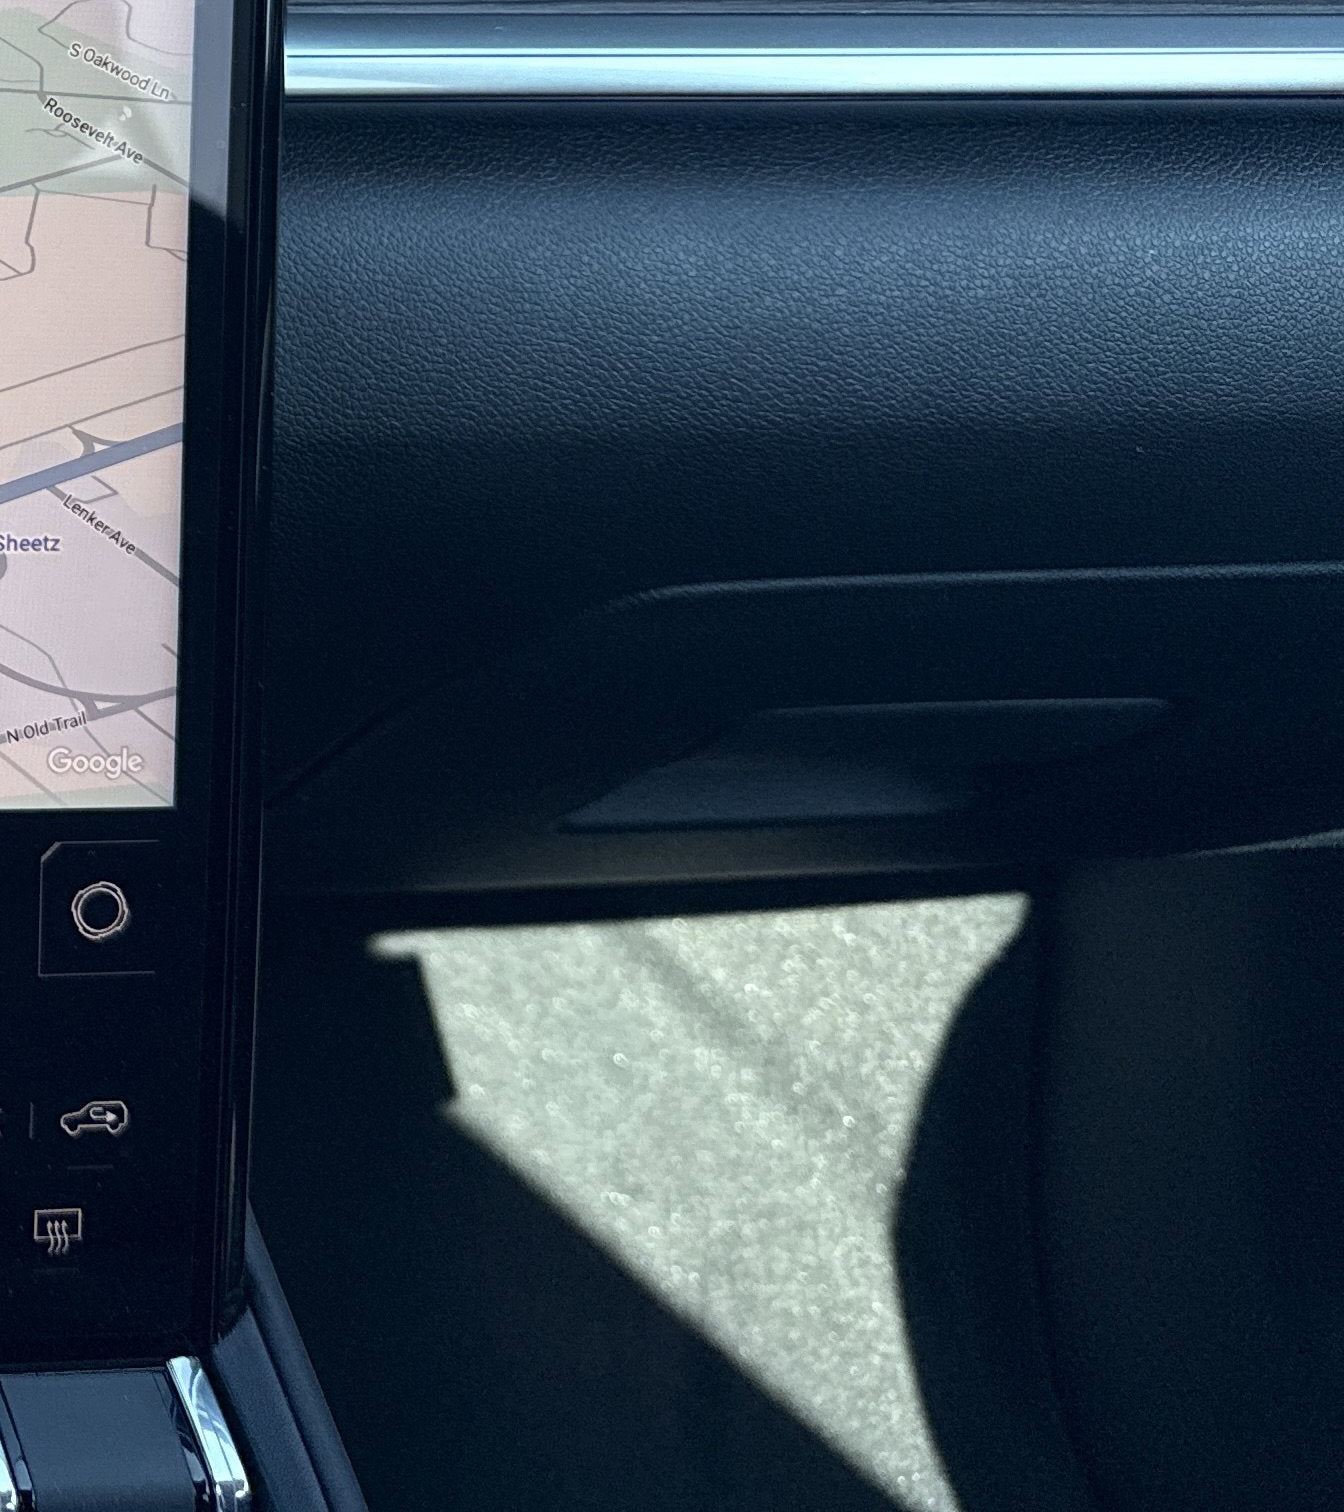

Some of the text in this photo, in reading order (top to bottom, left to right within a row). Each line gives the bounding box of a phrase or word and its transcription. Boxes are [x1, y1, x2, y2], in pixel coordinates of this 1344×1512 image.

[69, 43, 169, 101] S Oakwood Ln
[44, 97, 143, 164] Roosevelt Ave
[62, 495, 136, 555] Lenker Ave
[6, 712, 87, 745] N Old Trail
[48, 748, 143, 779] Google
